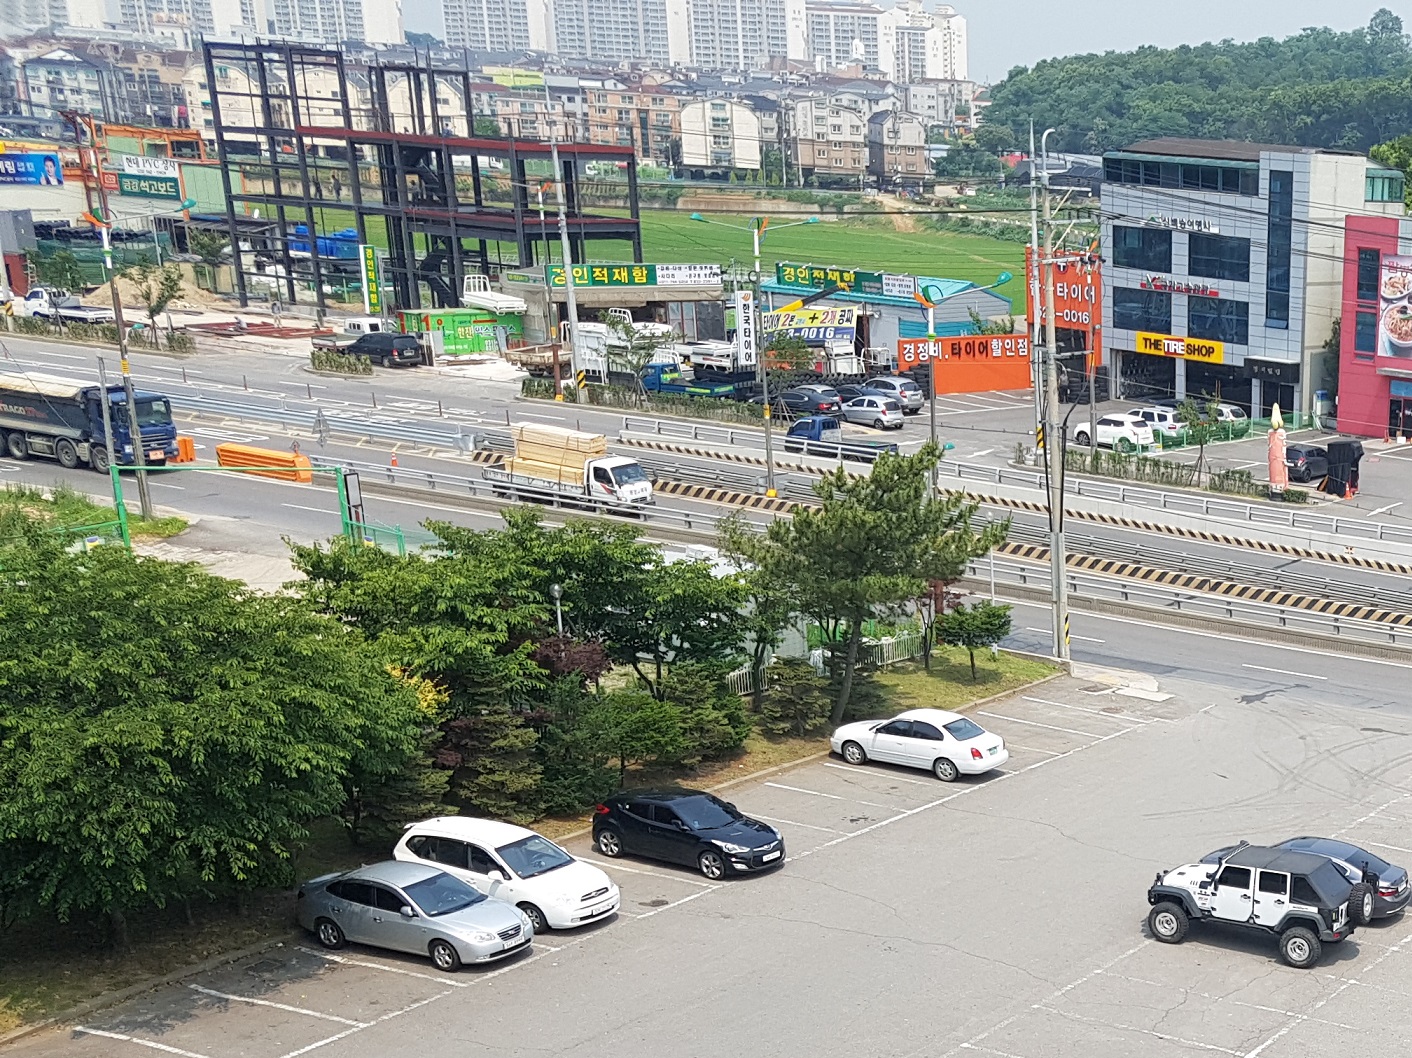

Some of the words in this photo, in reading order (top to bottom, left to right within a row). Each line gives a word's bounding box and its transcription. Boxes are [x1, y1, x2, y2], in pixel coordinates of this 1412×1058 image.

[142, 158, 159, 168] PVC
[140, 180, 177, 195] 석고보드
[552, 266, 648, 285] 경인적재함
[742, 303, 753, 363] 한국타이어
[951, 340, 989, 359] 타이어
[990, 337, 1029, 357] 할인점
[1142, 337, 1163, 351] THE
[1163, 339, 1186, 354] TIRE
[1186, 343, 1215, 358] SHOP
